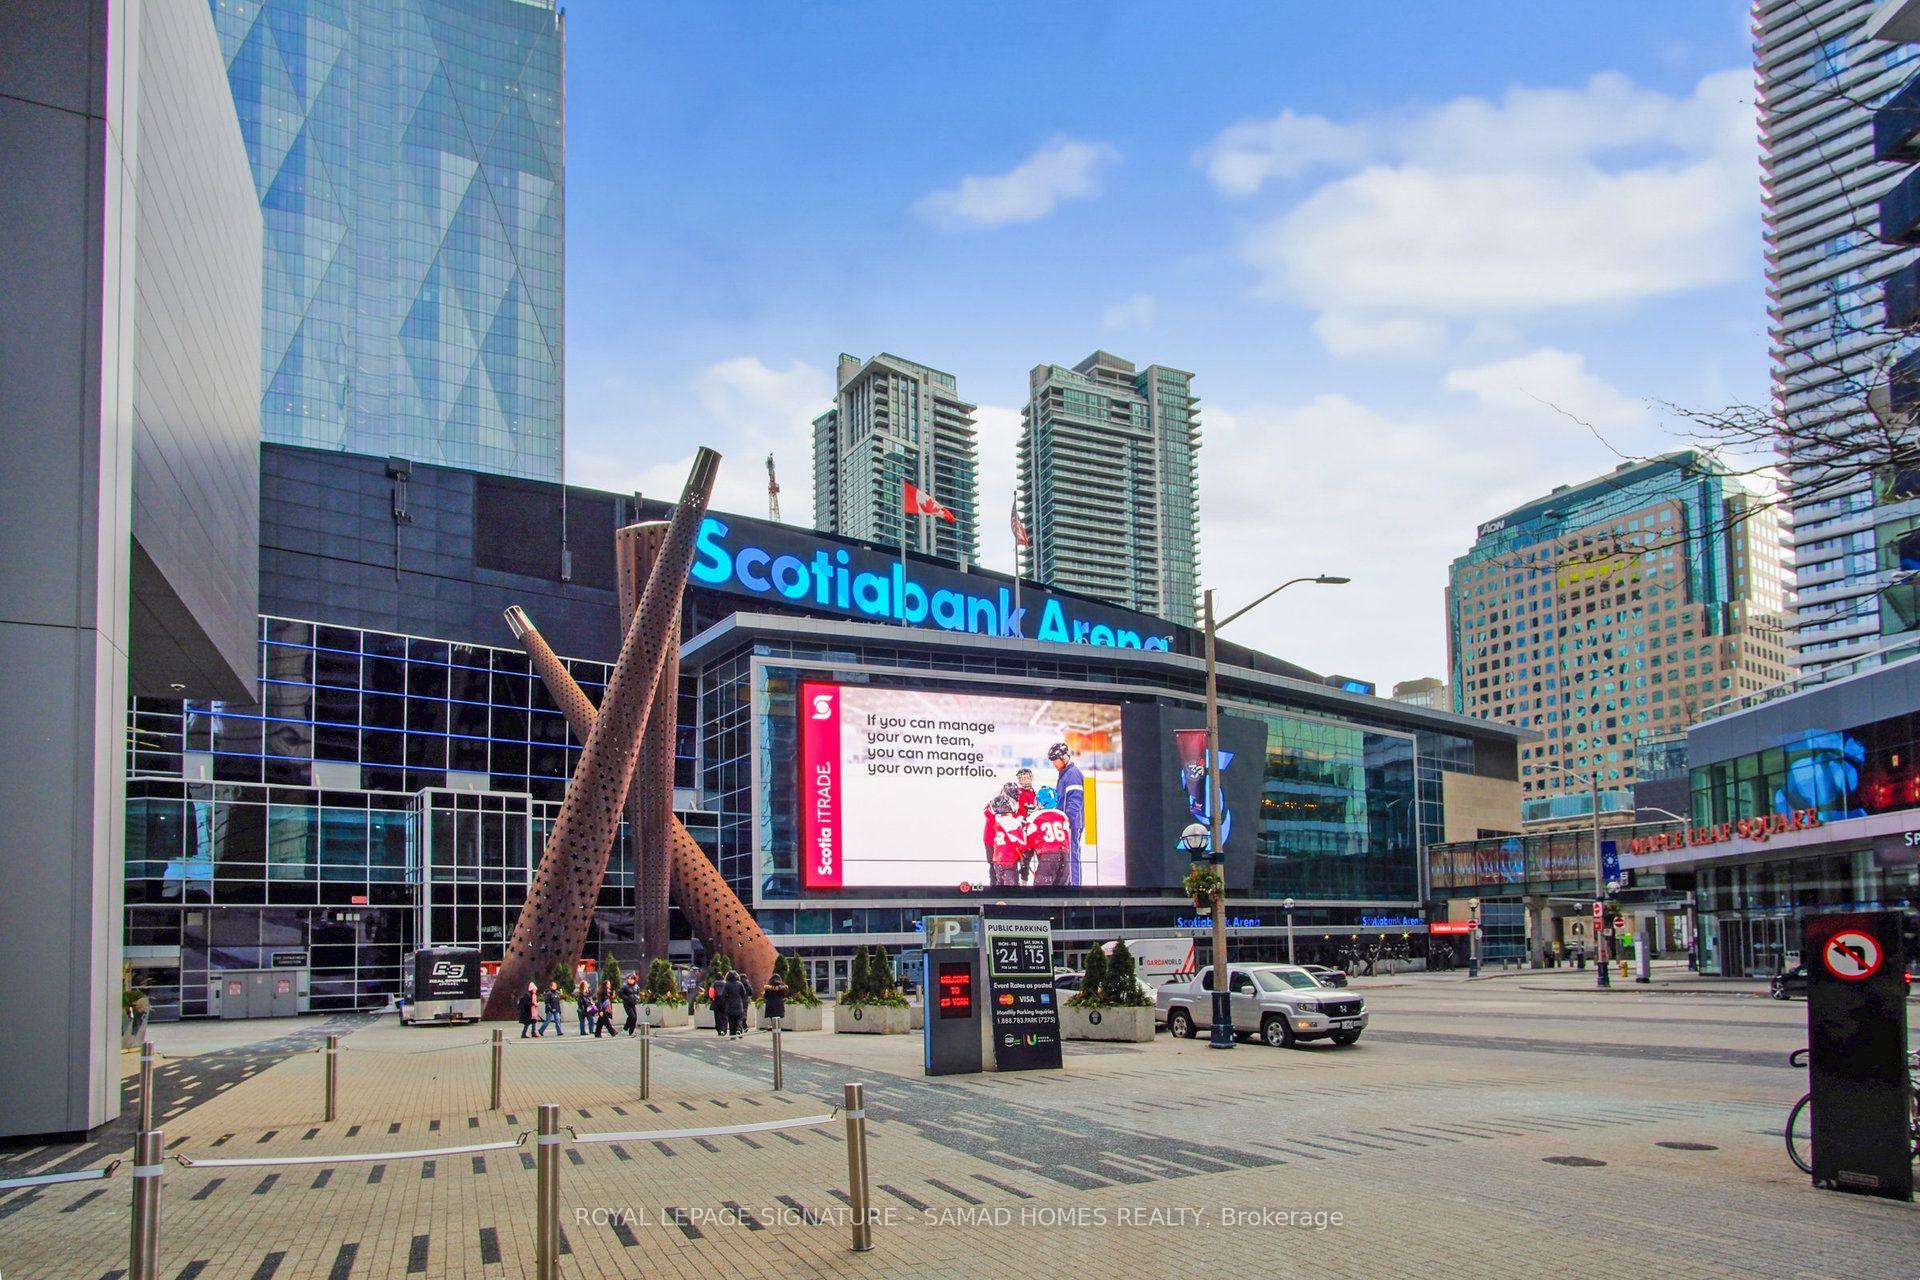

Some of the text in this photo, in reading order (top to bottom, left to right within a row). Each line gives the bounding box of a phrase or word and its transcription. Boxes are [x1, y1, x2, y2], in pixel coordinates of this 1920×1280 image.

[691, 518, 1026, 639] Scotiabank
[867, 714, 995, 735] If you can manage
[867, 732, 975, 748] your own team,
[867, 748, 984, 765] you can manage
[868, 764, 997, 778] your own portfolio.
[1041, 822, 1065, 843] 36
[1630, 807, 1822, 856] MAPLE LEAF SQUARE
[818, 827, 832, 876] Scotia
[971, 884, 984, 892] LG
[988, 924, 1048, 933] PUBLIC PARKING
[1177, 916, 1260, 928] Scotiabk Arena
[944, 921, 961, 944] P
[996, 948, 1019, 963] $24
[1024, 948, 1045, 964] $15
[1146, 958, 1183, 966] GARDAWORLD
[940, 974, 970, 984] WELCOME
[1033, 982, 1053, 990] posted
[950, 986, 960, 995] TO
[1019, 995, 1035, 1003] VISA
[1035, 1008, 1055, 1016] Inquiries
[1038, 1016, 1056, 1024] (7275)
